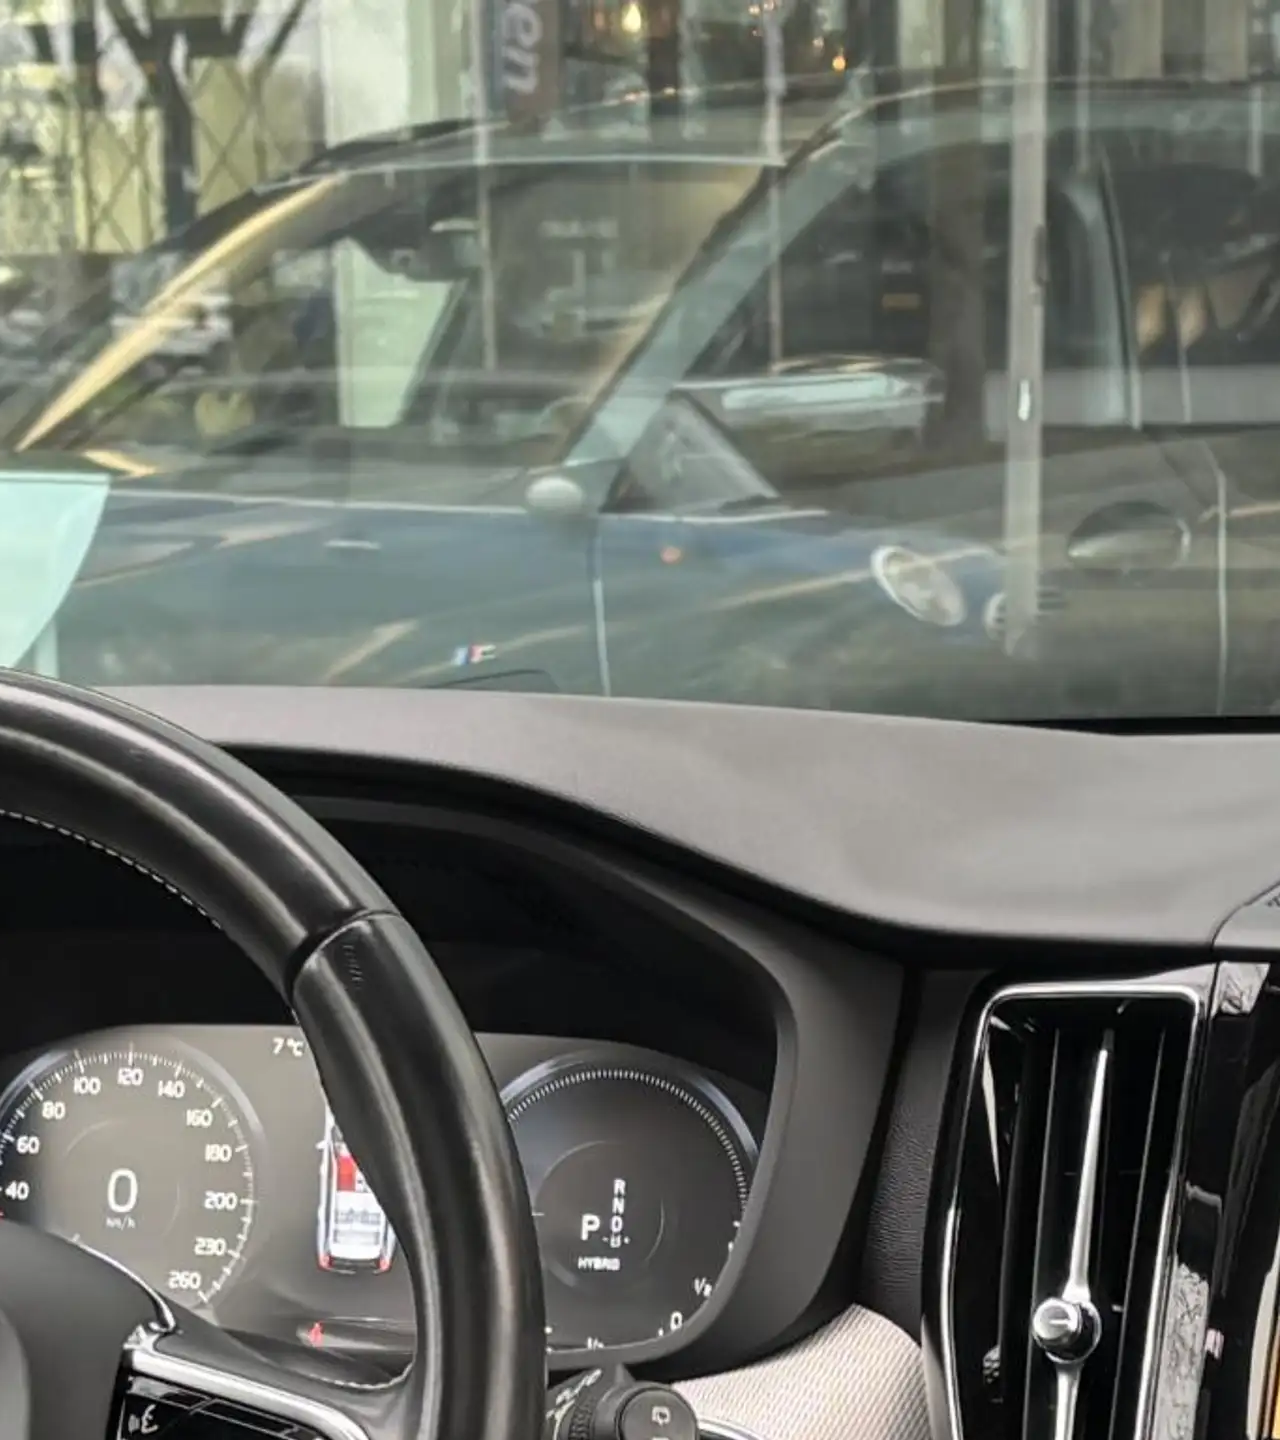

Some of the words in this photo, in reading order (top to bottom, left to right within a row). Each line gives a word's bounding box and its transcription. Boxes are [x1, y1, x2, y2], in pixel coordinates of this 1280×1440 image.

[499, 0, 543, 95] en
[273, 1037, 285, 1055] 7
[73, 1076, 101, 1095] 100
[117, 1068, 144, 1086] 120
[158, 1080, 185, 1099] 140
[41, 1101, 66, 1120] 80
[186, 1109, 213, 1128] 160
[16, 1136, 40, 1154] 60
[205, 1144, 232, 1163] 180
[5, 1181, 30, 1200] 40
[107, 1167, 139, 1214] 0
[204, 1191, 238, 1210] 200
[581, 1213, 601, 1241] P
[194, 1237, 227, 1256] 230
[168, 1272, 202, 1290] 260
